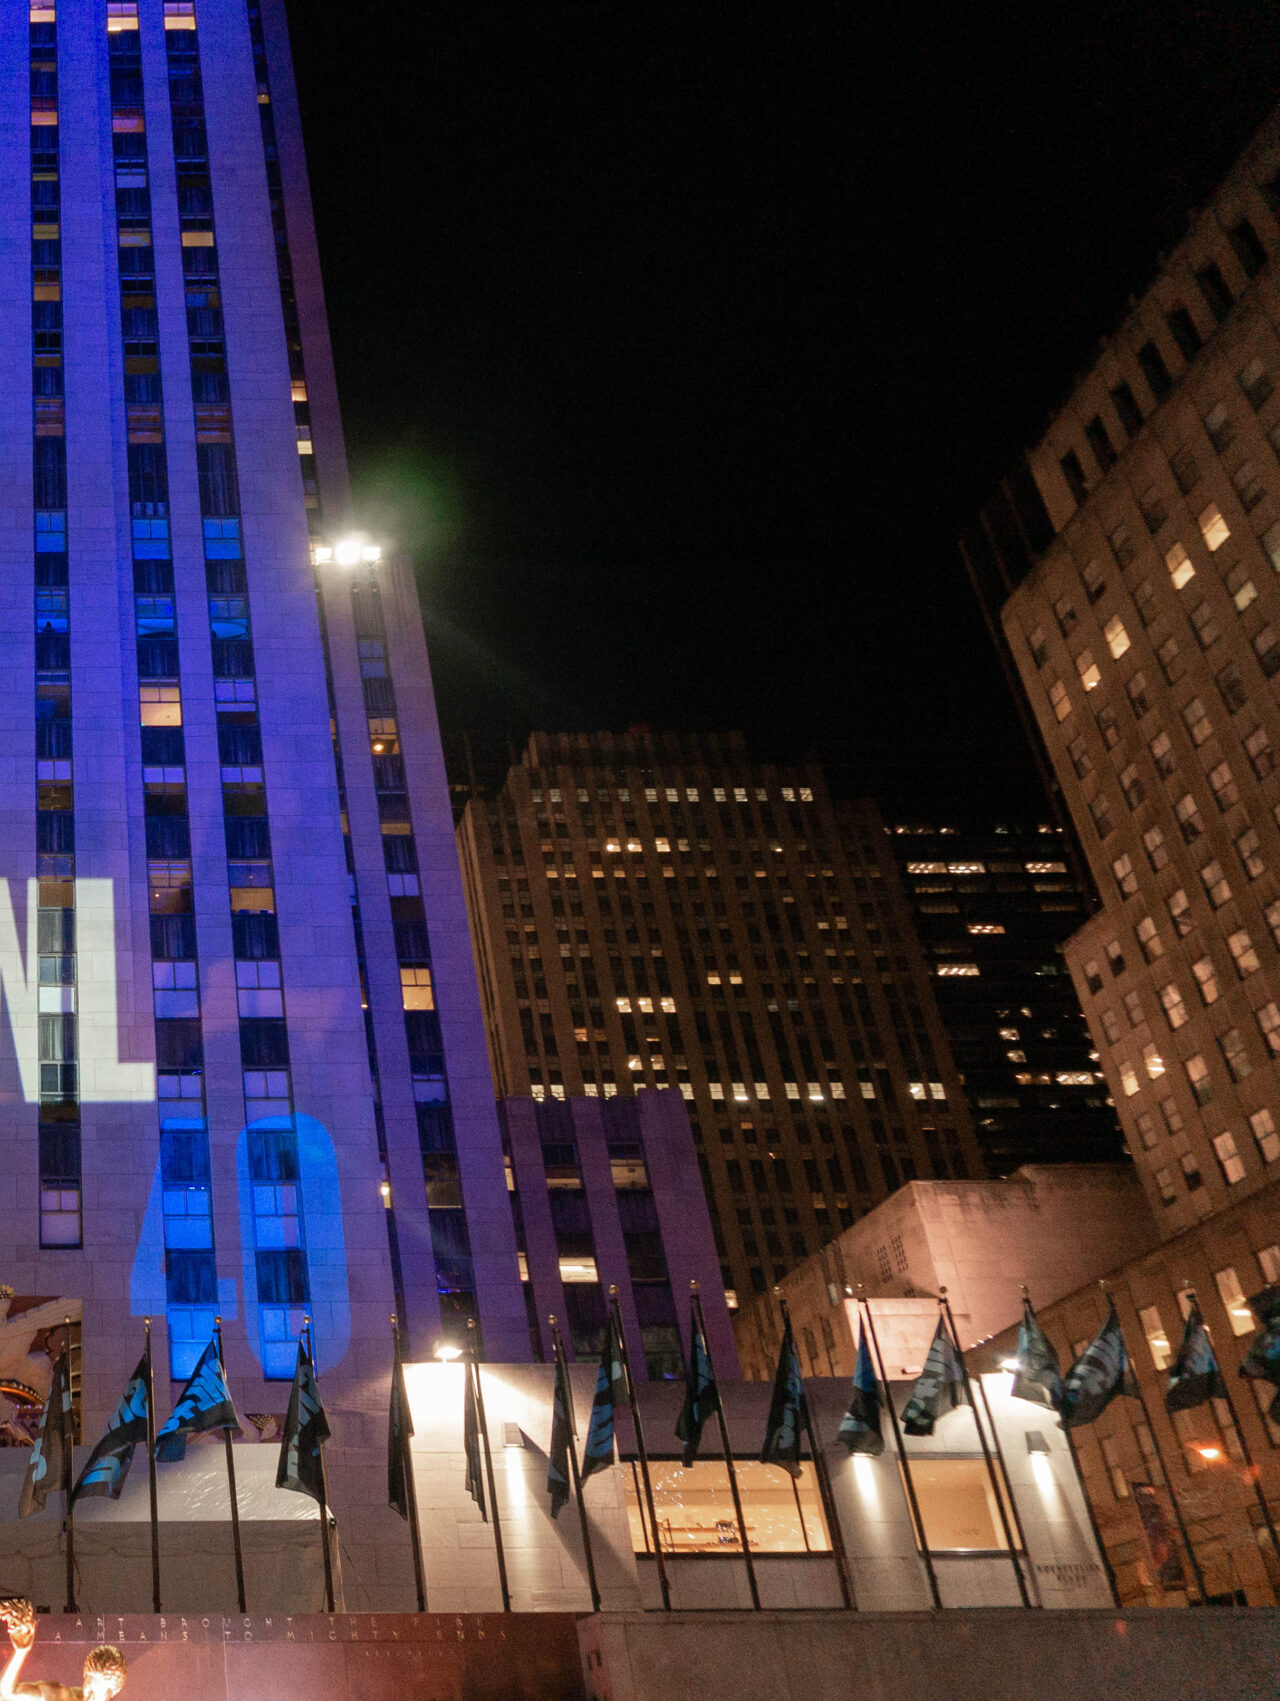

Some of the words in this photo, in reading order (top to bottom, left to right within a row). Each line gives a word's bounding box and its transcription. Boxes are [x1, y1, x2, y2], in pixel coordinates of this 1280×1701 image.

[130, 1112, 352, 1380] 40
[75, 1617, 125, 1629] ART
[329, 1617, 378, 1628] THE
[96, 1630, 188, 1642] MEANS
[224, 1630, 253, 1641] TO
[286, 1630, 400, 1641] MIGHTY
